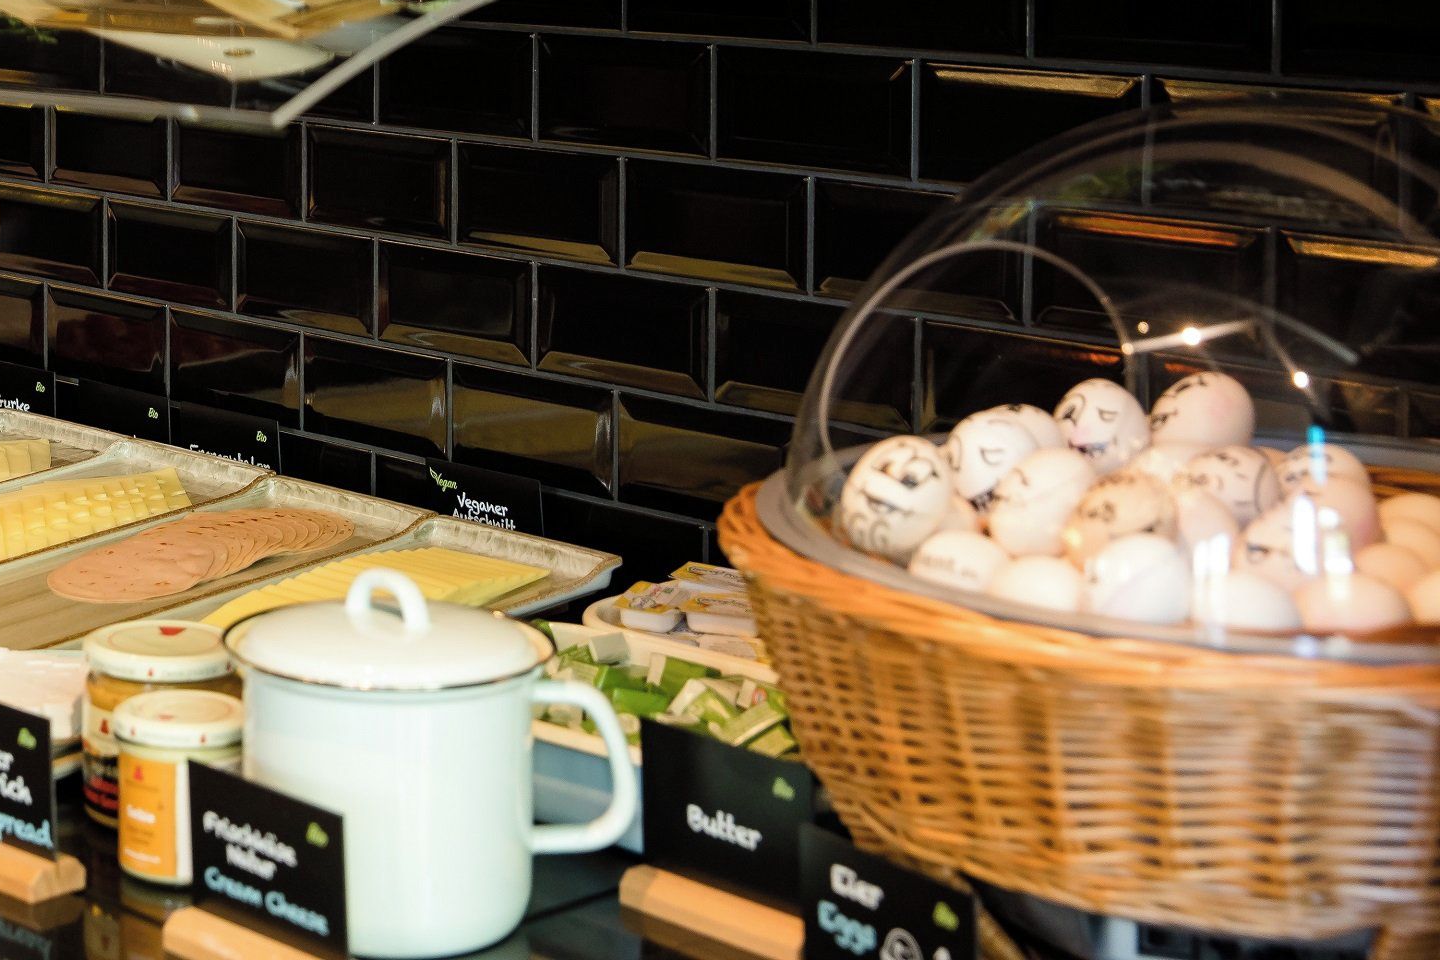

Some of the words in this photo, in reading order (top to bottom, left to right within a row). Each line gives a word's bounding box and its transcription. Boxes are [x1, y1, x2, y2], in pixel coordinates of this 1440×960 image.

[35, 381, 45, 393] Bio
[148, 407, 159, 419] Bio
[256, 431, 267, 443] Bio
[435, 472, 458, 492] Vegan
[457, 492, 508, 517] Veganer
[686, 803, 762, 852] Butter
